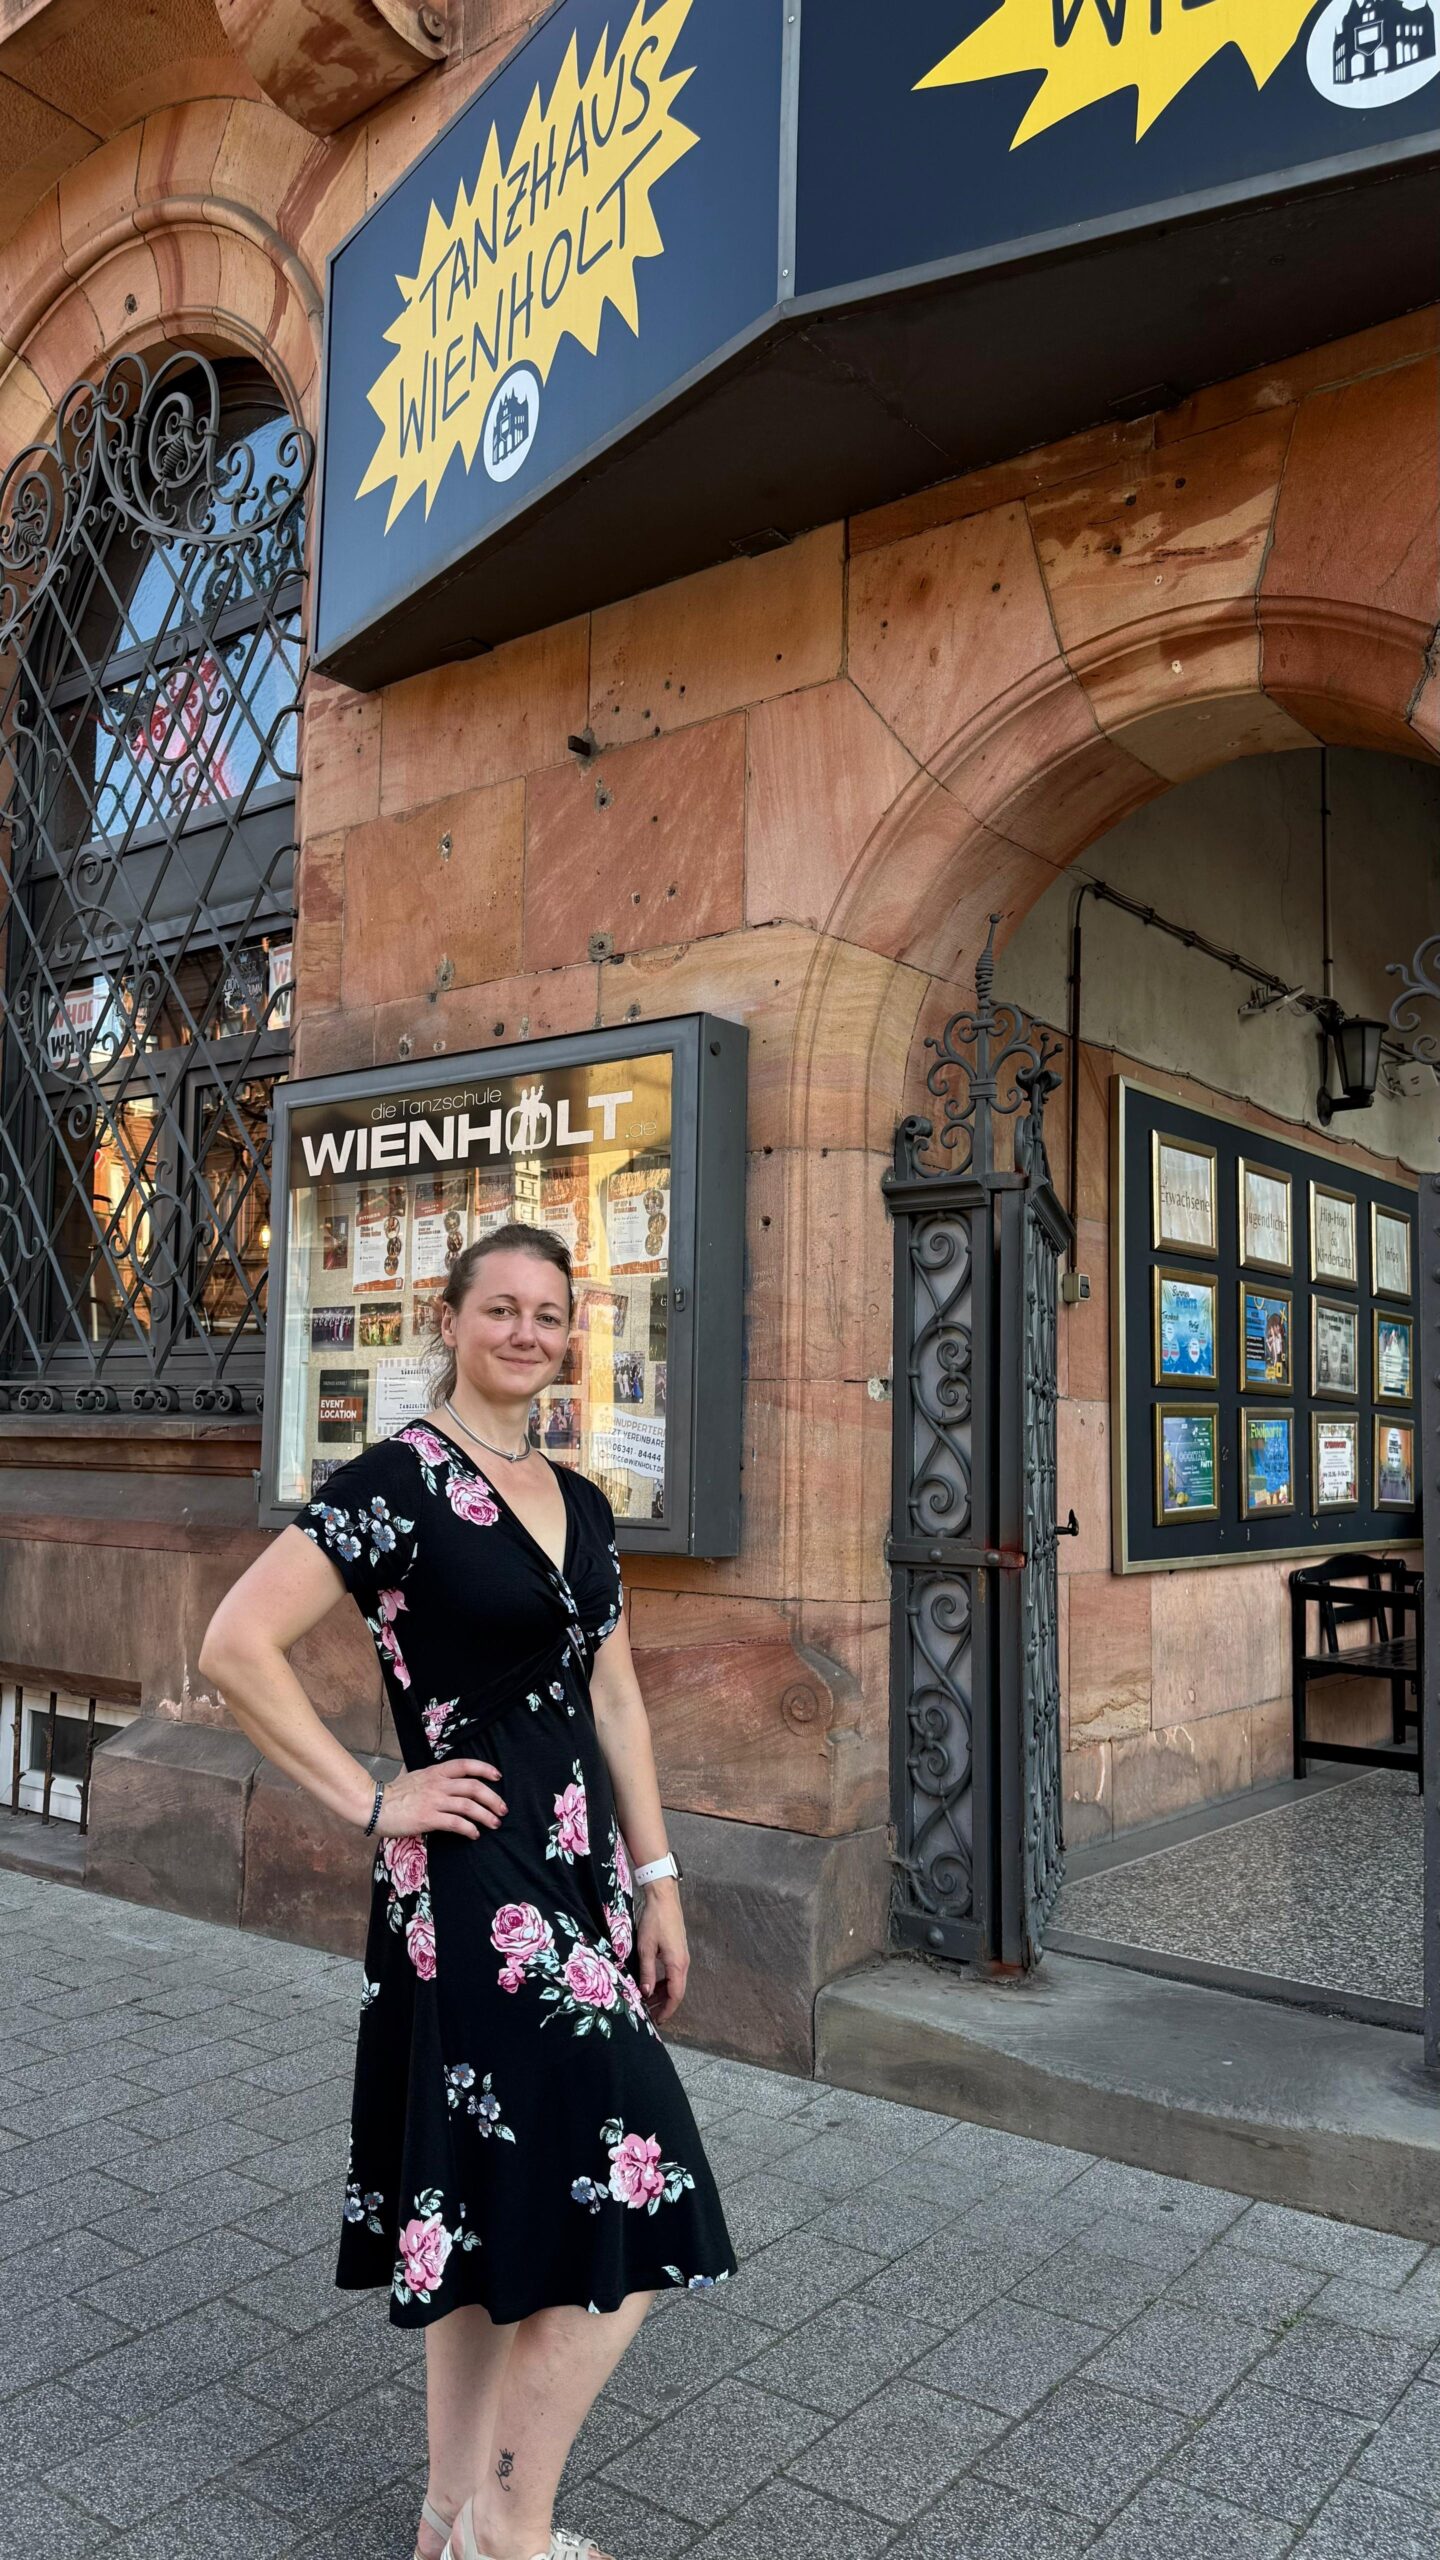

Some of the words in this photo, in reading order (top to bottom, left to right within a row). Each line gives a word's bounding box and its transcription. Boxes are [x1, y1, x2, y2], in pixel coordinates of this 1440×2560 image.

[1049, 0, 1216, 47] WI
[418, 35, 659, 338] TANZHAUS
[399, 129, 662, 458] WIENHOLT
[371, 1102, 396, 1120] die
[398, 1086, 502, 1116] Tanzschule
[1160, 1191, 1210, 1213] Erwachsene
[1245, 1206, 1288, 1232] Jugendliche
[1320, 1206, 1347, 1231] Hip-Hop
[1317, 1247, 1351, 1270] Kindertanz
[1384, 1246, 1399, 1263] Infos
[320, 1399, 345, 1408] EVENT
[320, 1409, 357, 1419] LOCATION
[612, 1443, 633, 1455] 06341
[638, 1449, 661, 1461] 84444
